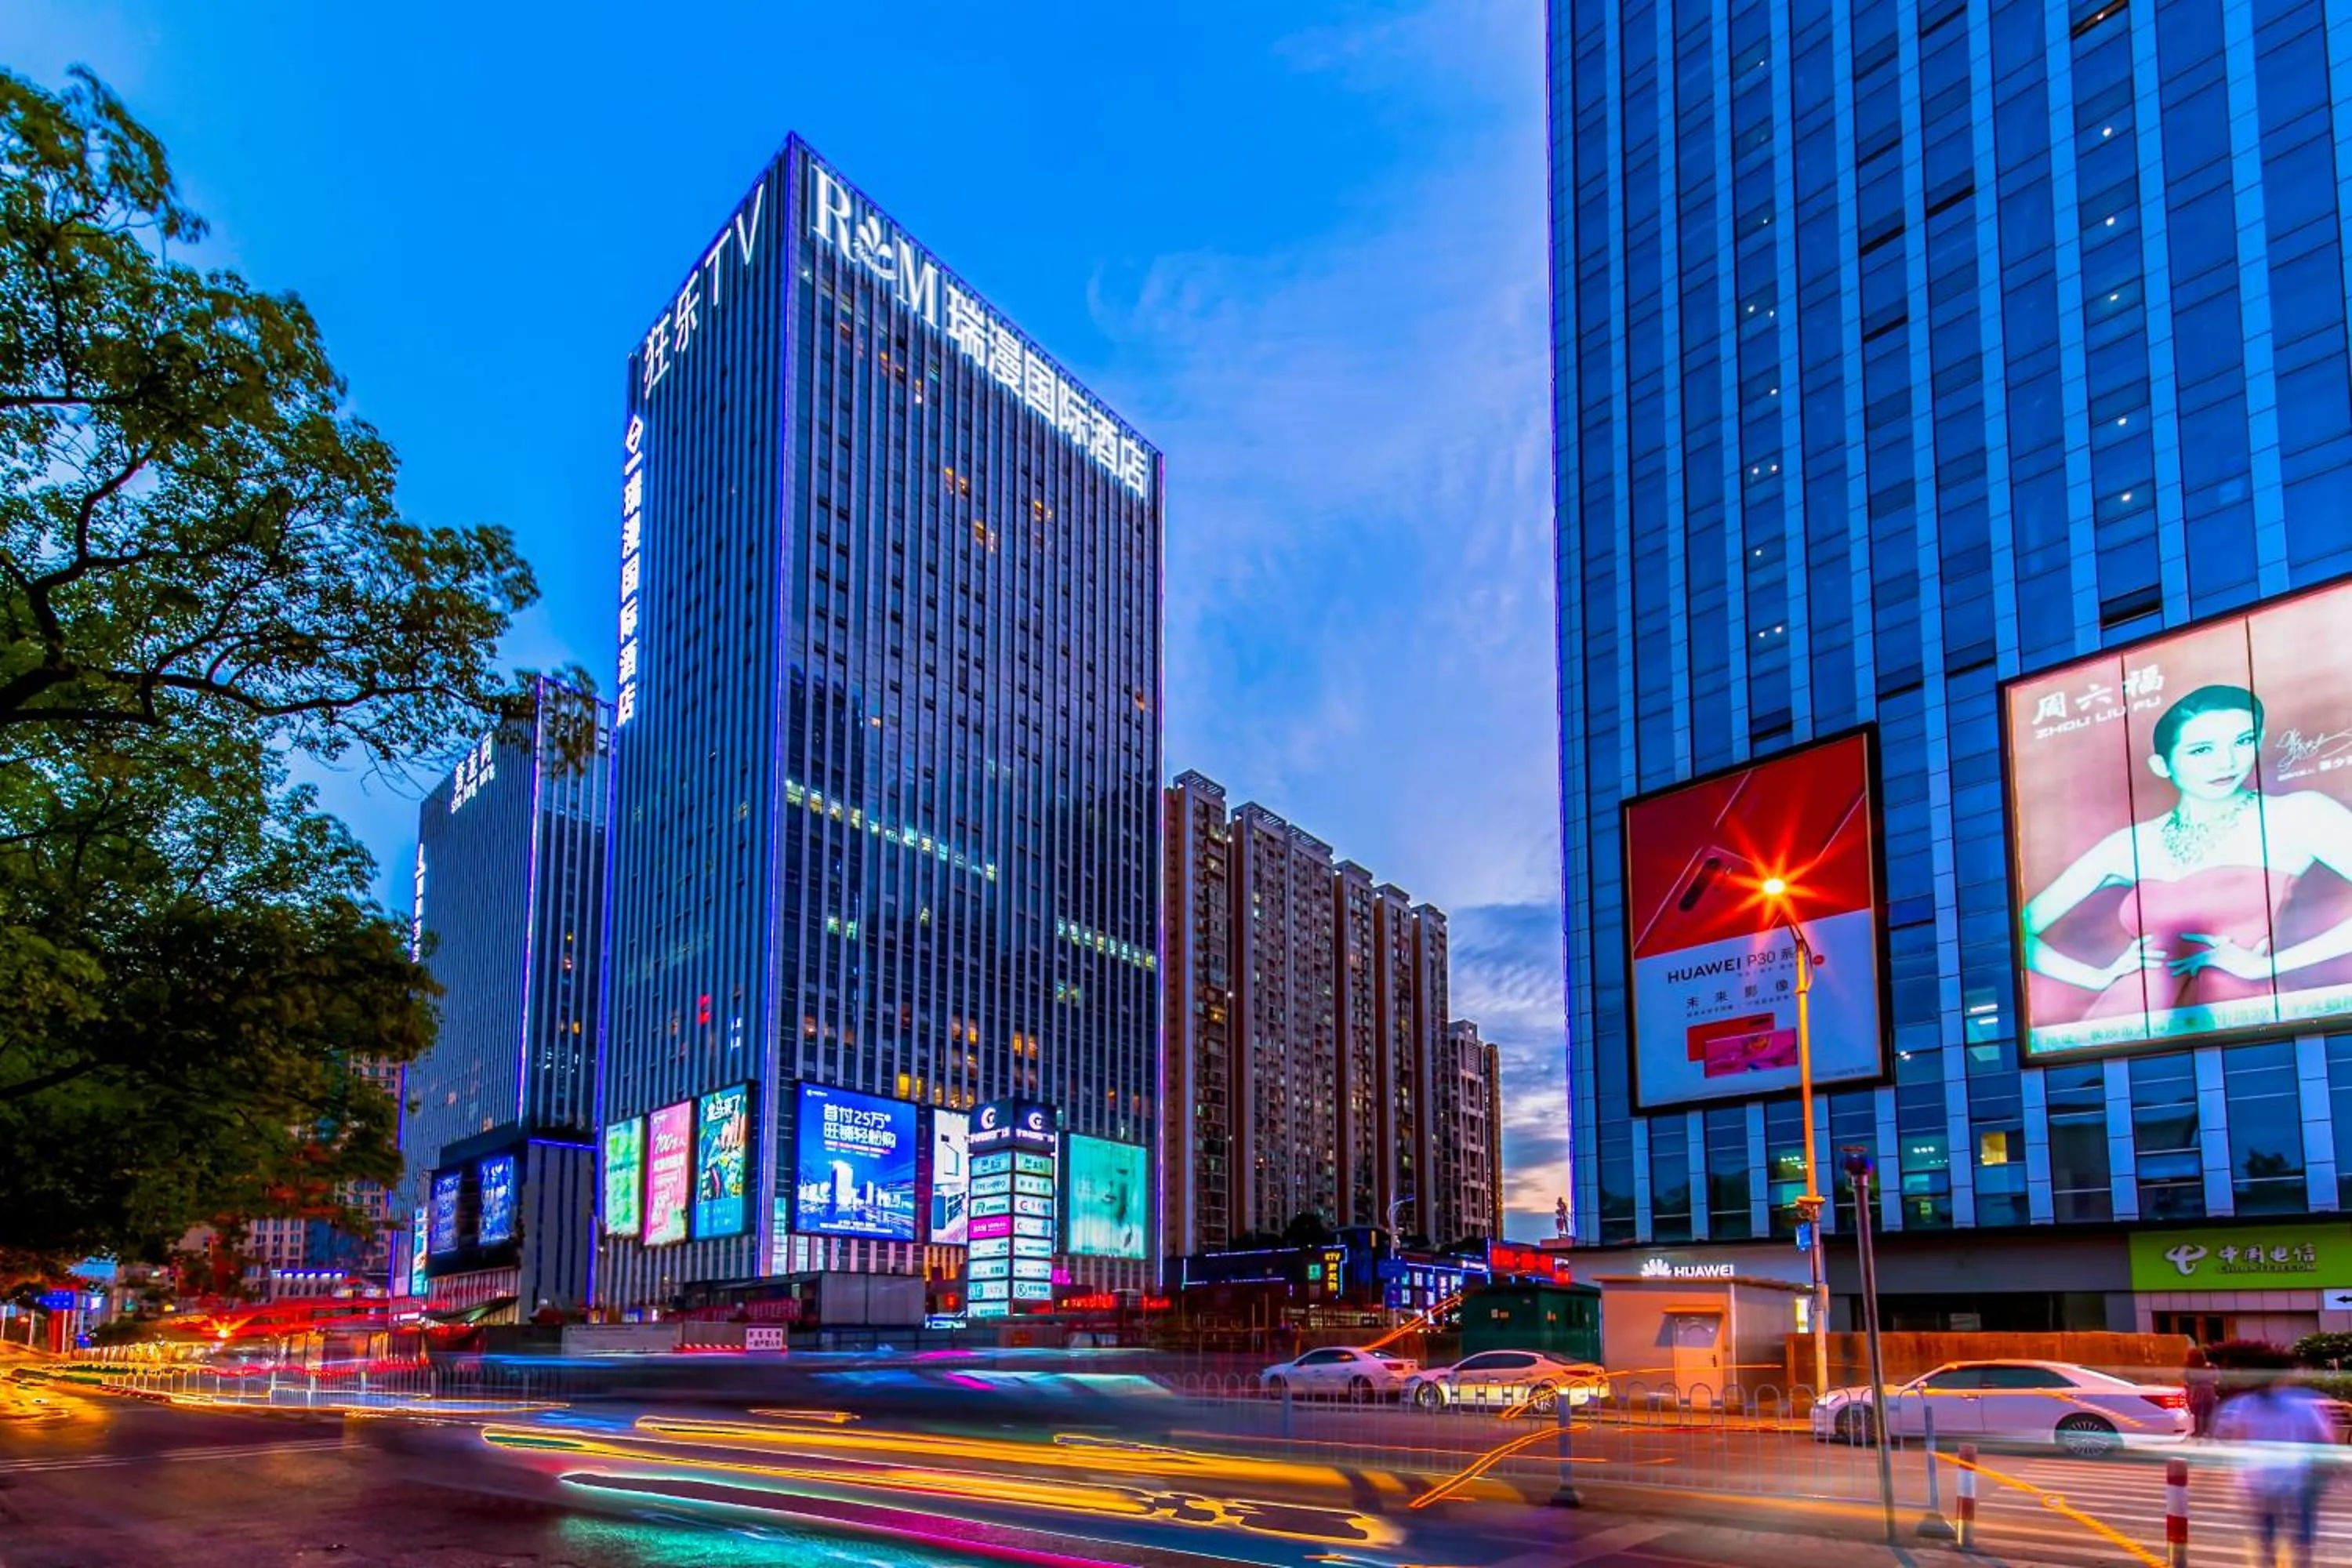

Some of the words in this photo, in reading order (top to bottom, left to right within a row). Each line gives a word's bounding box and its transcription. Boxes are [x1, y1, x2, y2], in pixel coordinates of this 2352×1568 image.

[946, 283, 1145, 497] 瑞漫国际酒店
[2032, 664, 2164, 725] 周六福
[2035, 717, 2091, 739] ZHOU
[2096, 706, 2126, 723] LIU
[2133, 696, 2161, 712] FU
[1668, 957, 1740, 984] HUAWEI
[1748, 952, 1776, 967] P30
[1674, 1264, 1734, 1277] HUAWEI
[2220, 1243, 2315, 1264] 中国电信
